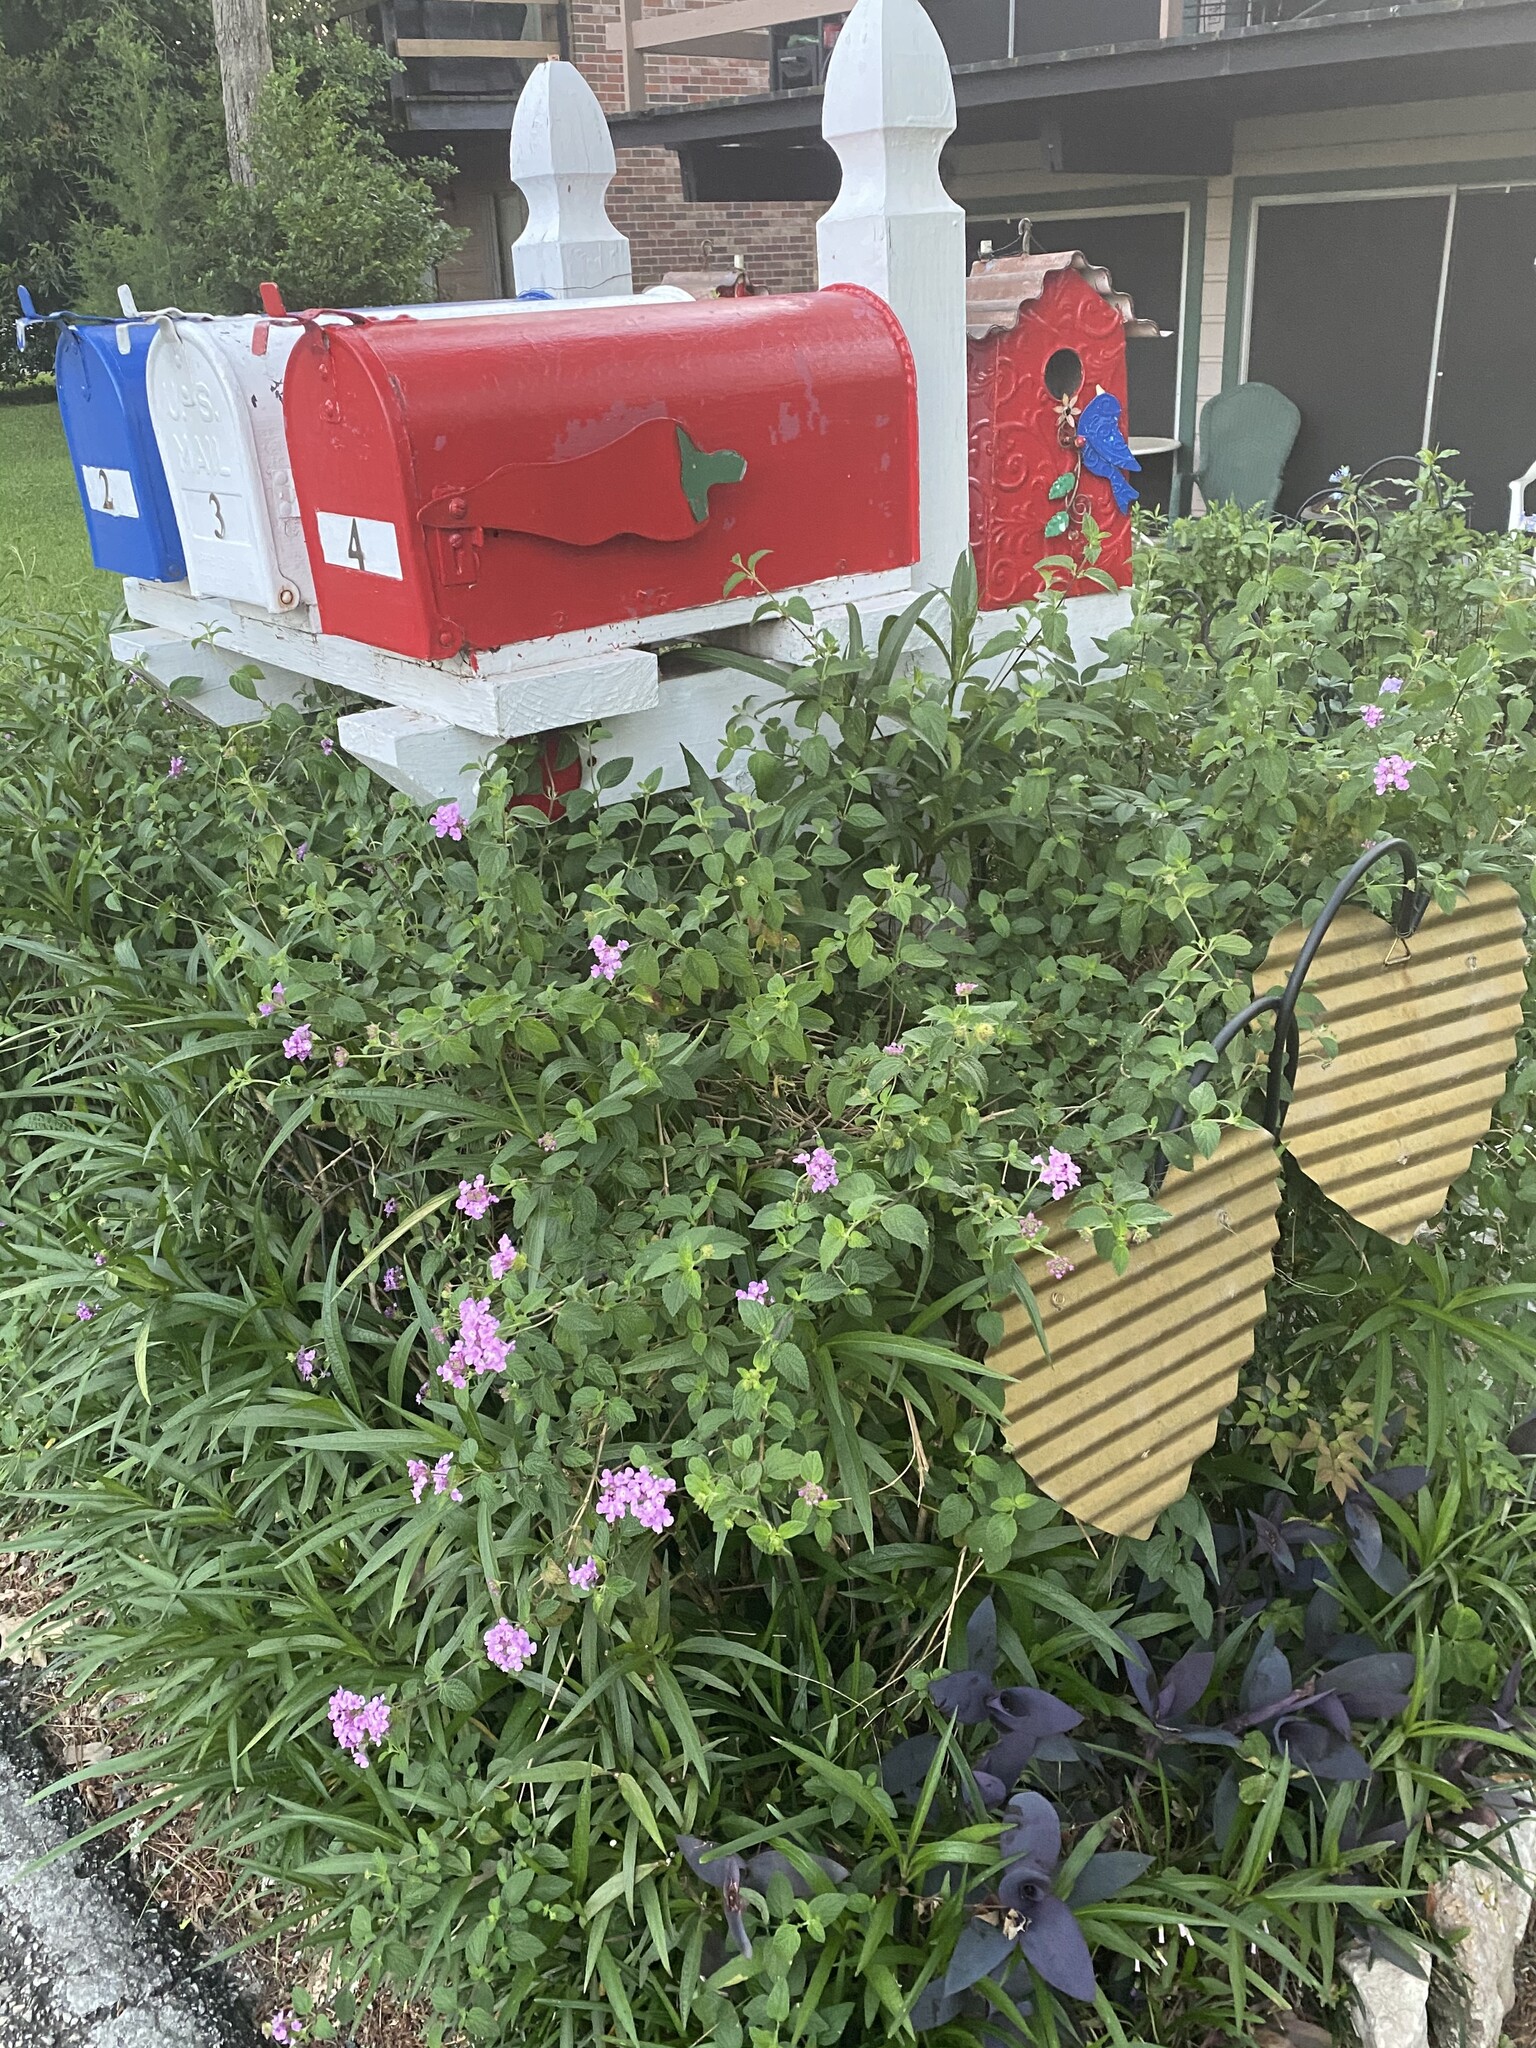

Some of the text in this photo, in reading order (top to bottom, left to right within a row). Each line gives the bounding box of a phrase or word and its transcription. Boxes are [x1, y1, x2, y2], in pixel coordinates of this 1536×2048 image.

[172, 433, 231, 478] MAIL
[99, 469, 114, 510] 2
[209, 492, 226, 540] 3
[348, 518, 365, 571] 4
